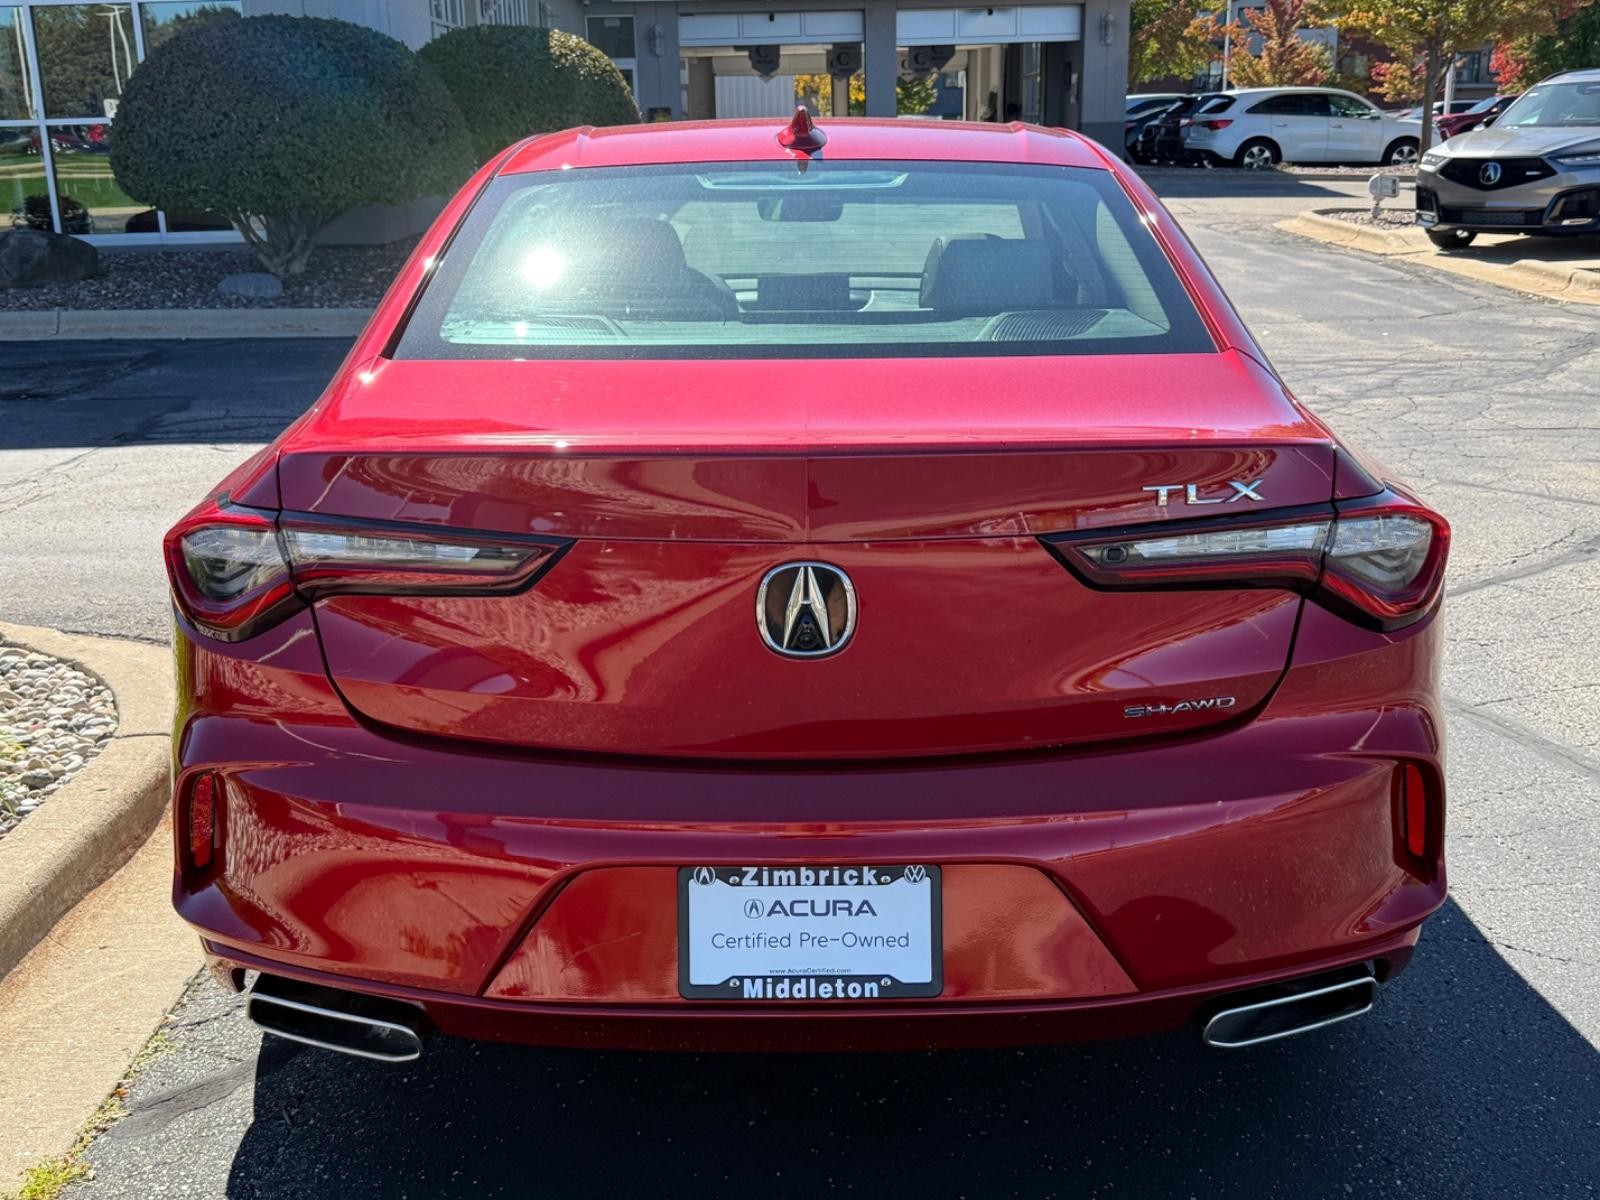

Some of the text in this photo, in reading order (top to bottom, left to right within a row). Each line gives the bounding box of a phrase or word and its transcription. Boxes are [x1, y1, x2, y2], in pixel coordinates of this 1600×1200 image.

[1142, 479, 1265, 507] TLX
[1124, 697, 1236, 718] SH-AWD
[741, 867, 878, 886] Zimbrick
[766, 899, 878, 917] ACURA
[711, 931, 910, 949] Certified Pre-Owned
[743, 978, 879, 998] Middleton
